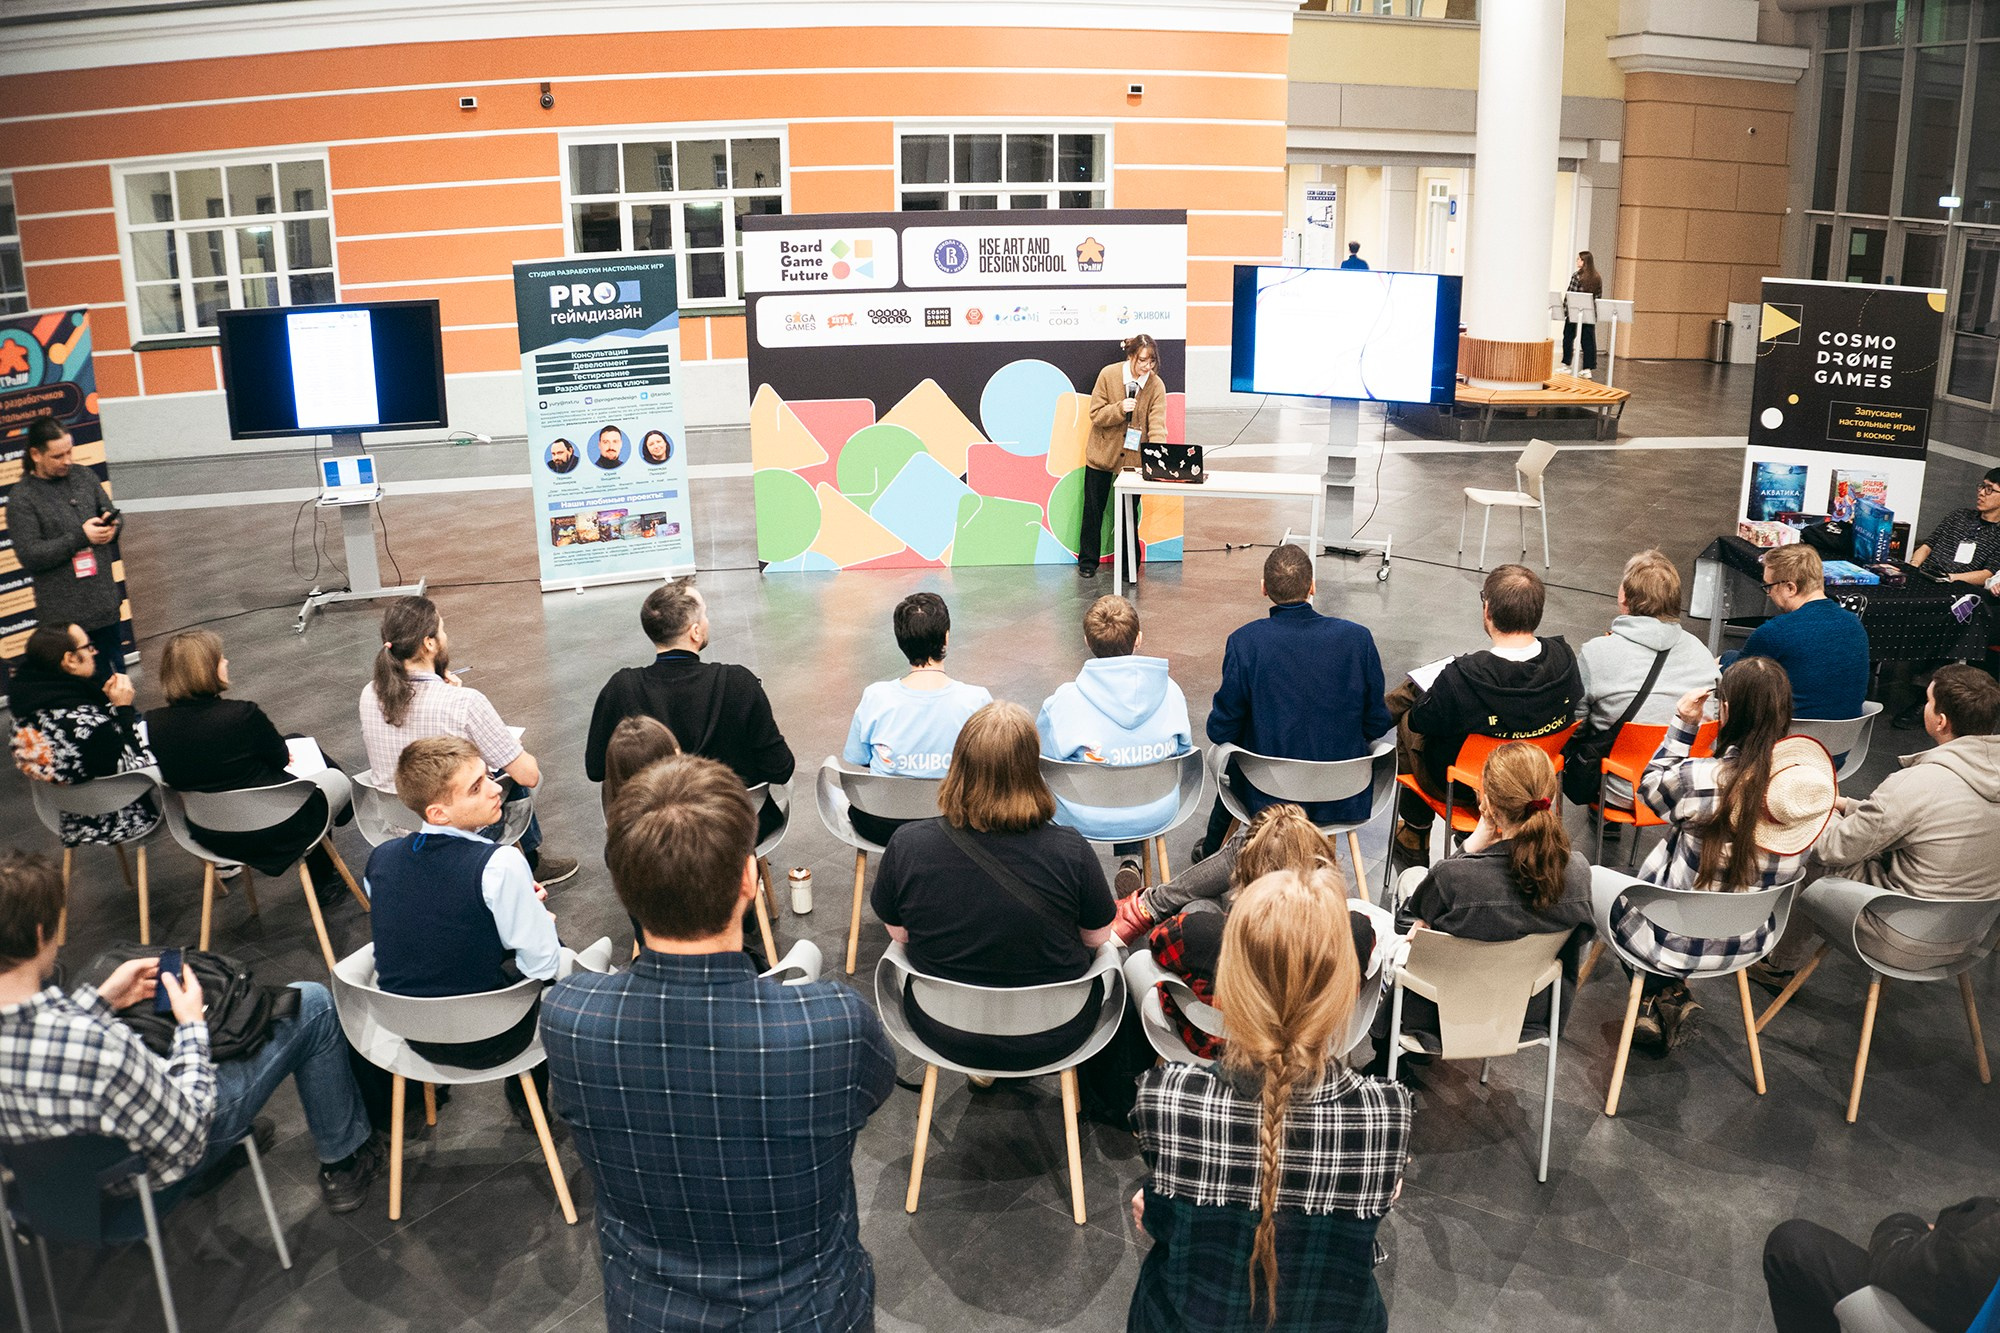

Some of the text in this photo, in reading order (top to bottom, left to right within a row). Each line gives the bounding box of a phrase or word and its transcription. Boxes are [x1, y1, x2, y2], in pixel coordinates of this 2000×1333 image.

[780, 239, 822, 253] Board
[979, 237, 1050, 255] HSE ART AND
[780, 255, 823, 267] Game
[979, 254, 1067, 273] DESIGN SCHOOL
[557, 267, 601, 276] РАЗРАБОТКИ
[602, 264, 650, 272] НАСТОЛЬНЫХ
[650, 262, 665, 270] ИГР
[781, 269, 829, 281] Future
[549, 281, 617, 308] PRO
[551, 304, 643, 325] геймдизайн
[1133, 311, 1171, 320] ЭКИВОКИ
[785, 323, 817, 331] GAMES
[1049, 318, 1079, 326] СОЮЗ
[1818, 331, 1896, 350] COSMO
[571, 349, 629, 360] Консультации
[573, 360, 629, 370] Девелопмент
[573, 370, 630, 380] Тестирование
[1814, 370, 1892, 389] GAMES
[555, 383, 602, 393] Разработка
[1855, 407, 1902, 419] Запускаем
[1839, 418, 1916, 432] настольные игры
[1863, 432, 1896, 441] космос
[1760, 489, 1800, 497] АКВАТИКА
[560, 500, 585, 508] Наши
[586, 496, 626, 506] любимые
[627, 492, 664, 502] проекты:
[1488, 715, 1498, 726] IF
[896, 752, 953, 770] ЭКИВО
